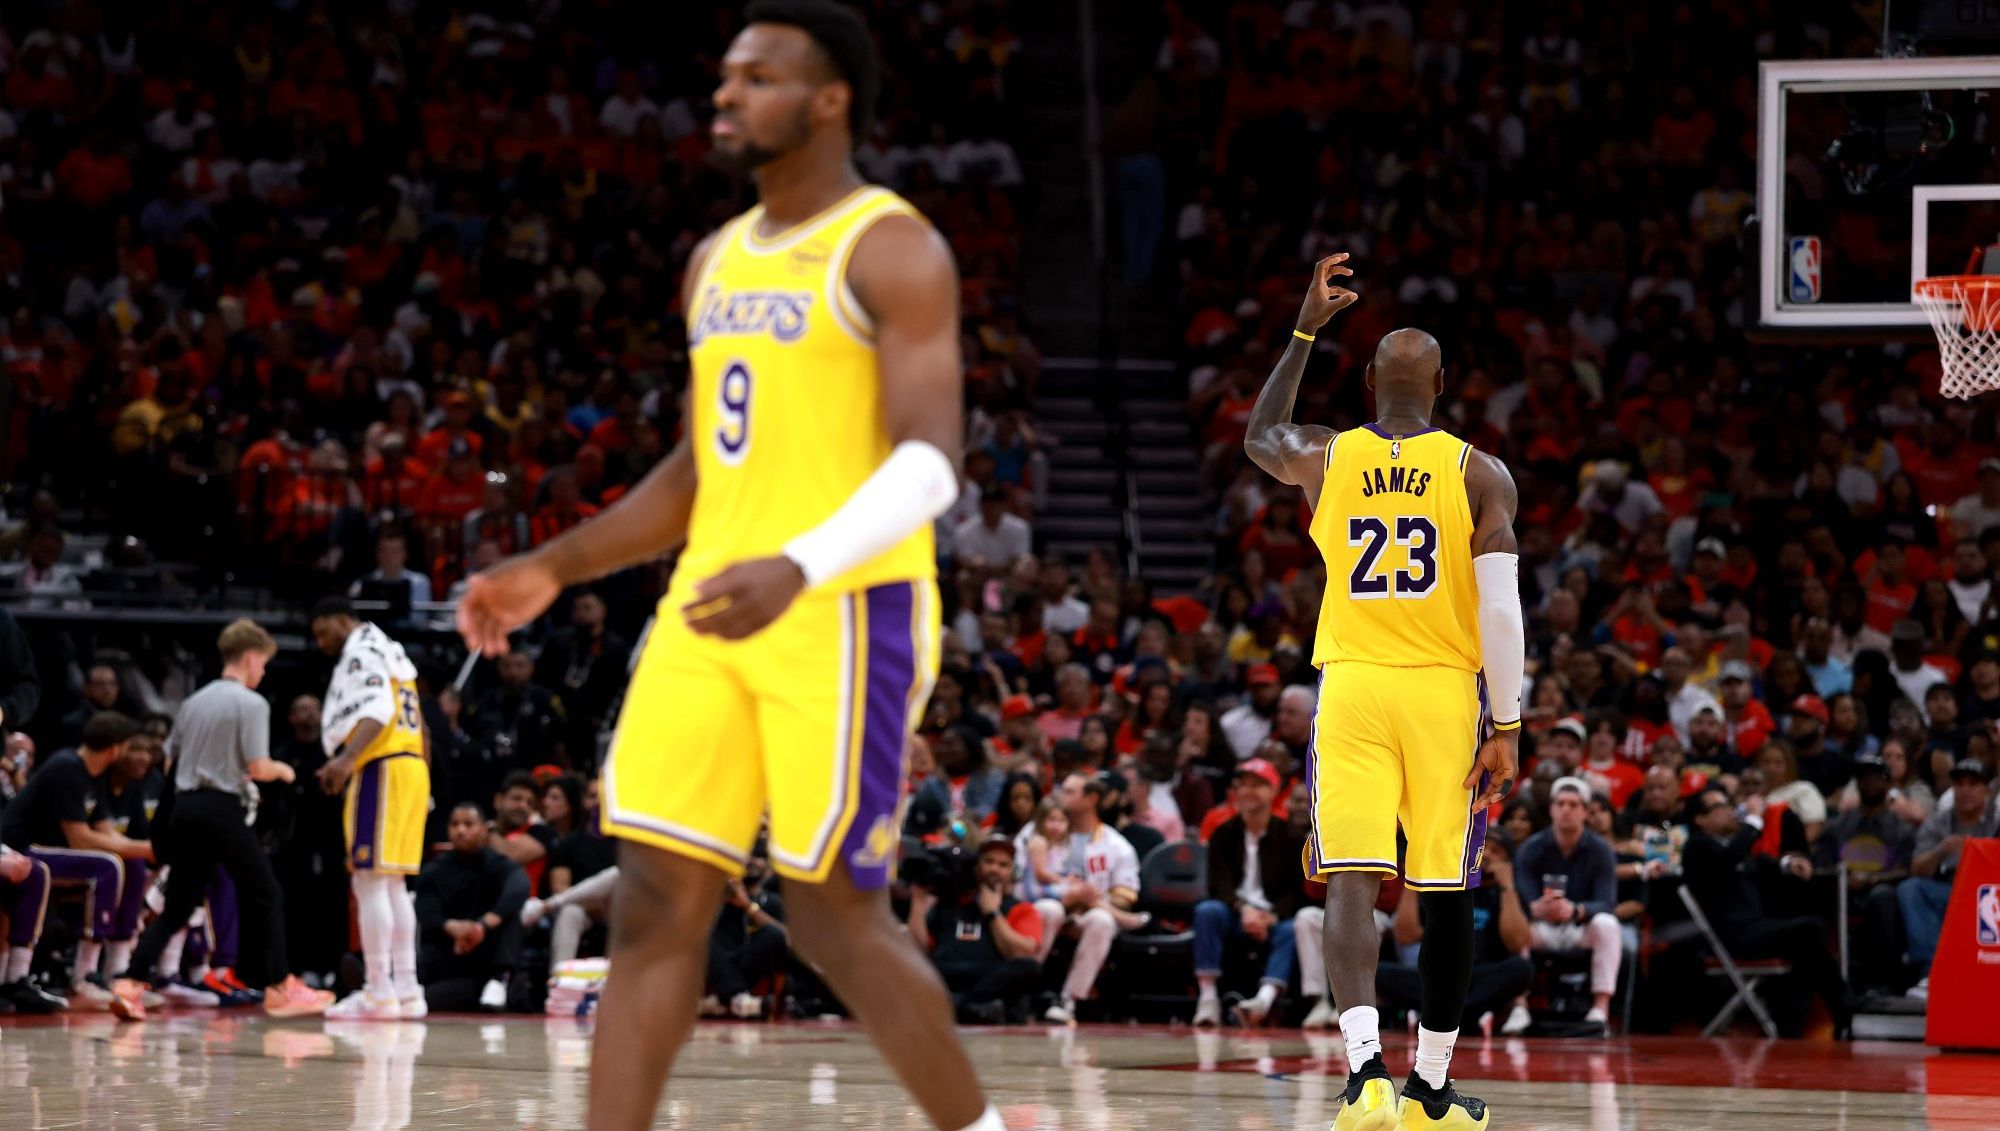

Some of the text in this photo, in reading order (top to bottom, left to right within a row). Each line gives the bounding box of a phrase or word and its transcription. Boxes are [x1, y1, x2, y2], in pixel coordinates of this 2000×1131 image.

[714, 358, 753, 463] 9
[1362, 466, 1431, 497] JAMES
[1348, 516, 1438, 599] 23
